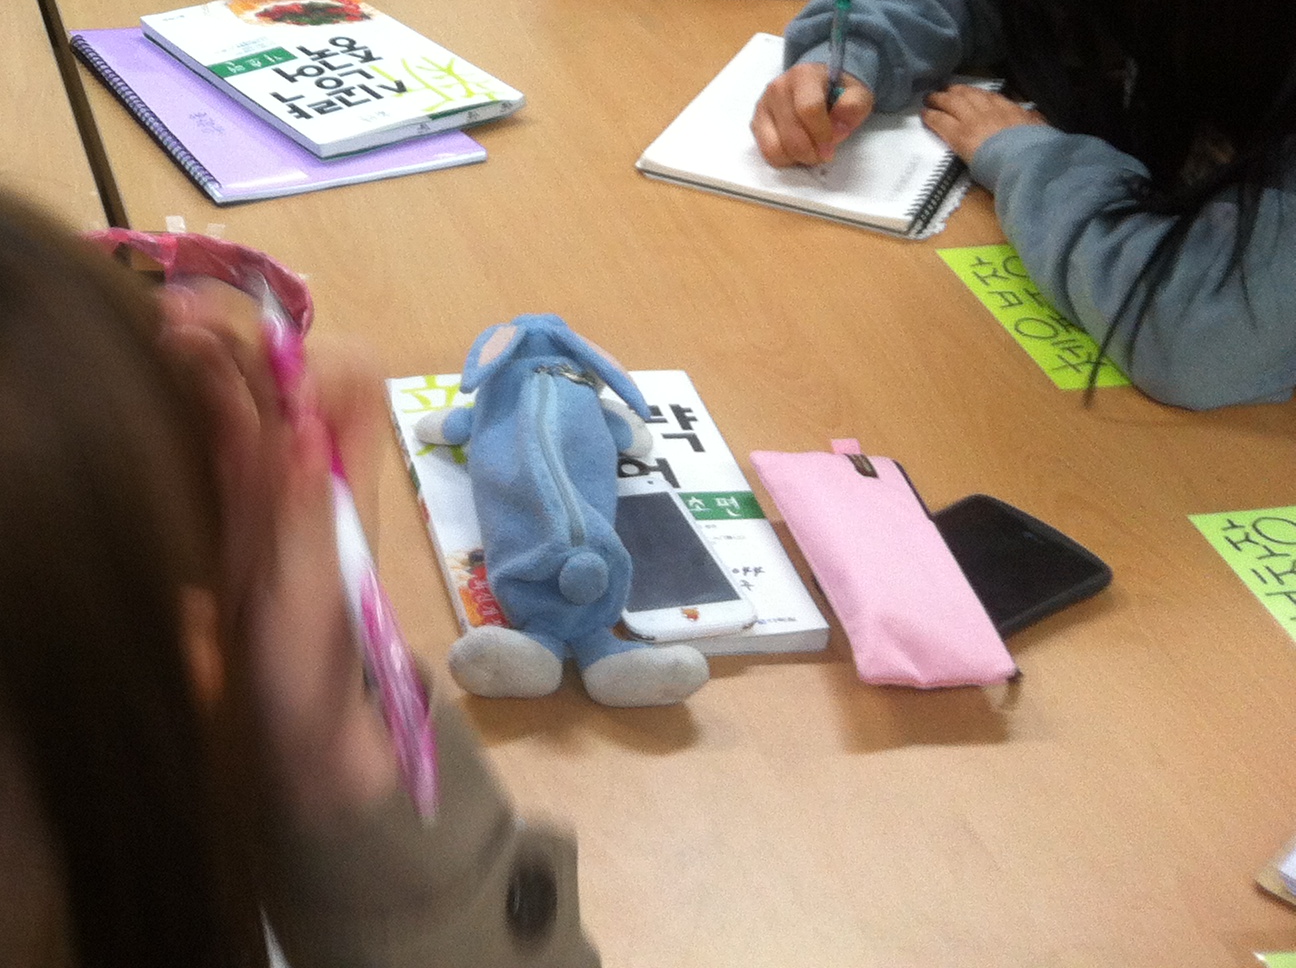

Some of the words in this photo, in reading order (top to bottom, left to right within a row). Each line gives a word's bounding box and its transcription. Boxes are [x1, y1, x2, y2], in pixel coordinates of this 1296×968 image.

[270, 36, 383, 83] 중국어
[269, 68, 408, 119] 신공략
[685, 495, 742, 518] 초편
